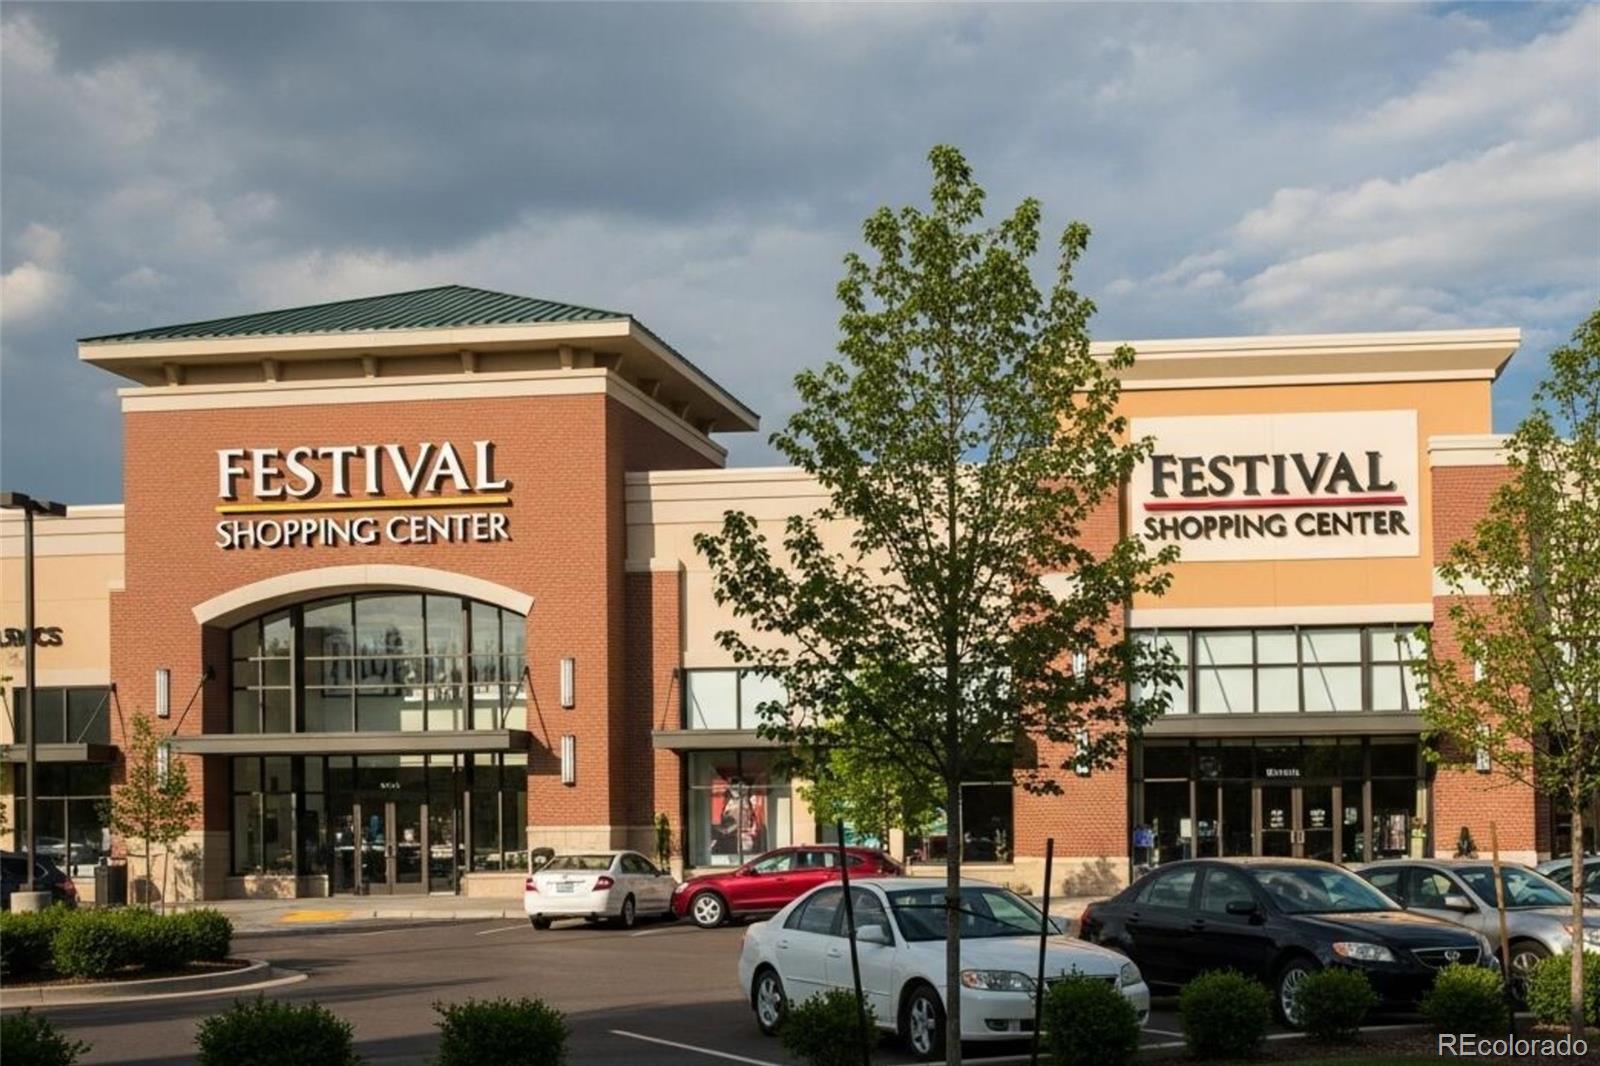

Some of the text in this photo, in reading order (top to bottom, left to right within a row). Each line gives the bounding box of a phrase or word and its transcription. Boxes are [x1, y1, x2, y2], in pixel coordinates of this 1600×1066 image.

[216, 440, 511, 499] FESTIVAL
[1149, 451, 1396, 498] FESTIVAL
[215, 512, 511, 549] SHOPPING CENTER
[1143, 510, 1410, 541] SHOPPING CENTER
